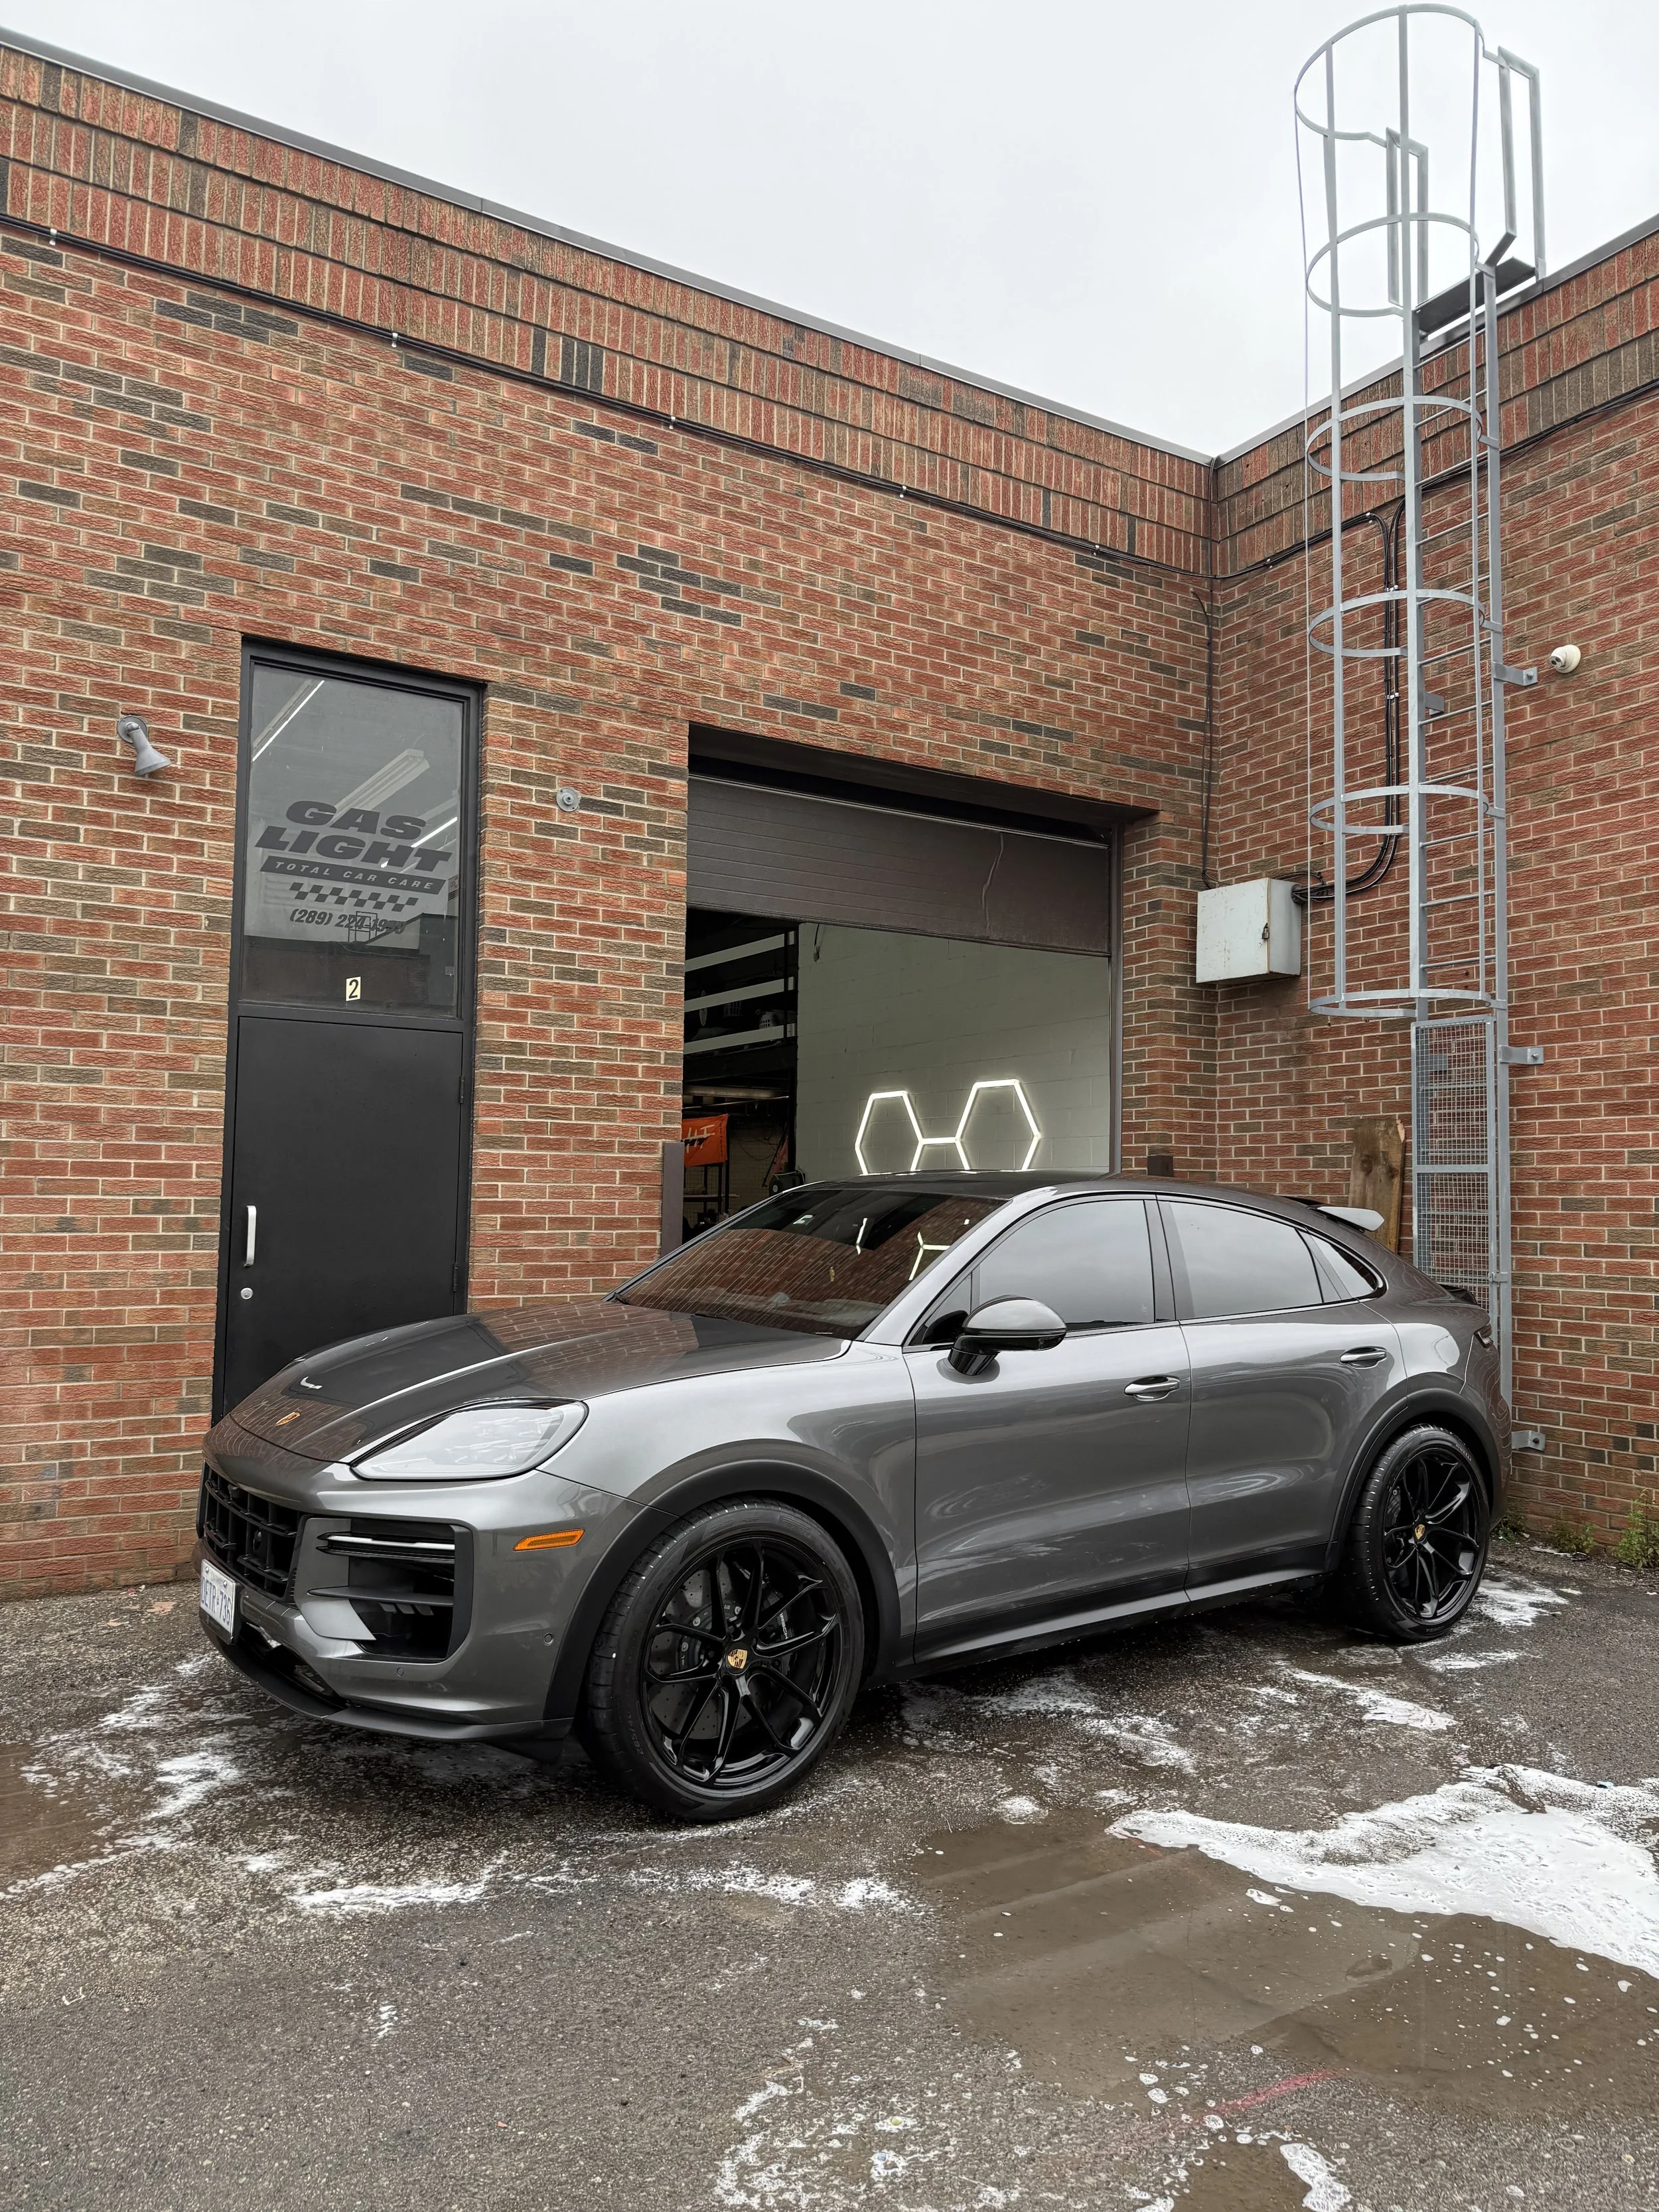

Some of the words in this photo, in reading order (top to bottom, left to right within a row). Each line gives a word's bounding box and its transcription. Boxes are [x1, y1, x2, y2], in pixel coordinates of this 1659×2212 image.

[286, 800, 426, 840] GAS
[255, 826, 453, 872] LIGHT
[275, 861, 330, 875] TOTAL
[342, 871, 377, 882] CAR
[388, 877, 433, 889] CARE
[289, 909, 333, 926] (289)
[348, 979, 359, 999] 2
[219, 1590, 232, 1625] 736
